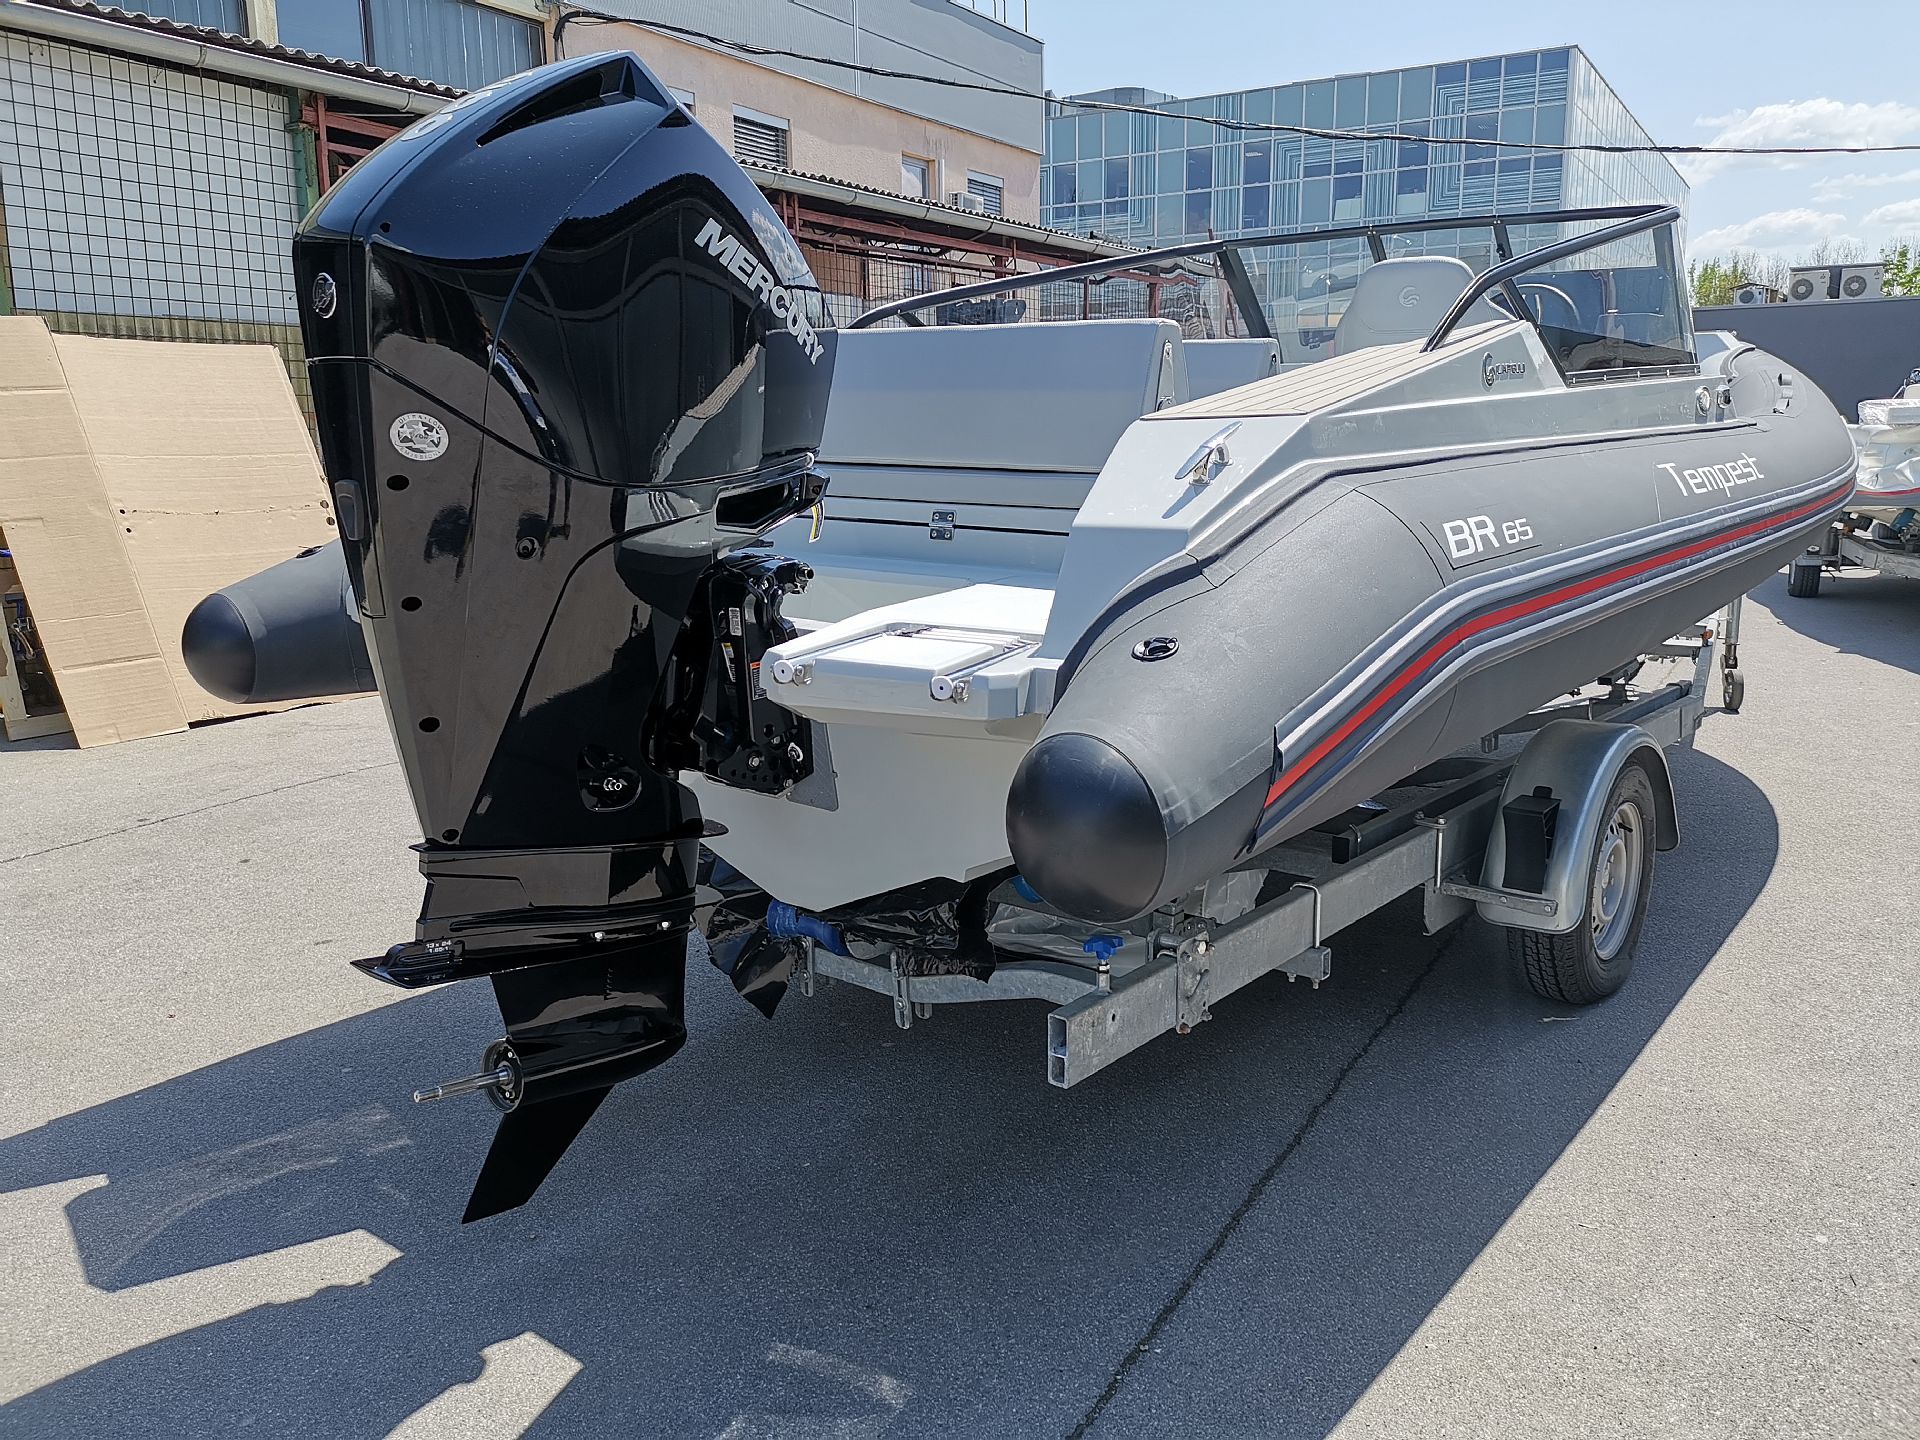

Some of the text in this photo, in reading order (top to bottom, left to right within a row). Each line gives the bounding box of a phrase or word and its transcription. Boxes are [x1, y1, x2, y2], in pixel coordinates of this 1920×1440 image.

[694, 217, 825, 366] MERCURY
[1656, 452, 1765, 498] Tempest
[1442, 515, 1533, 558] BR 65
